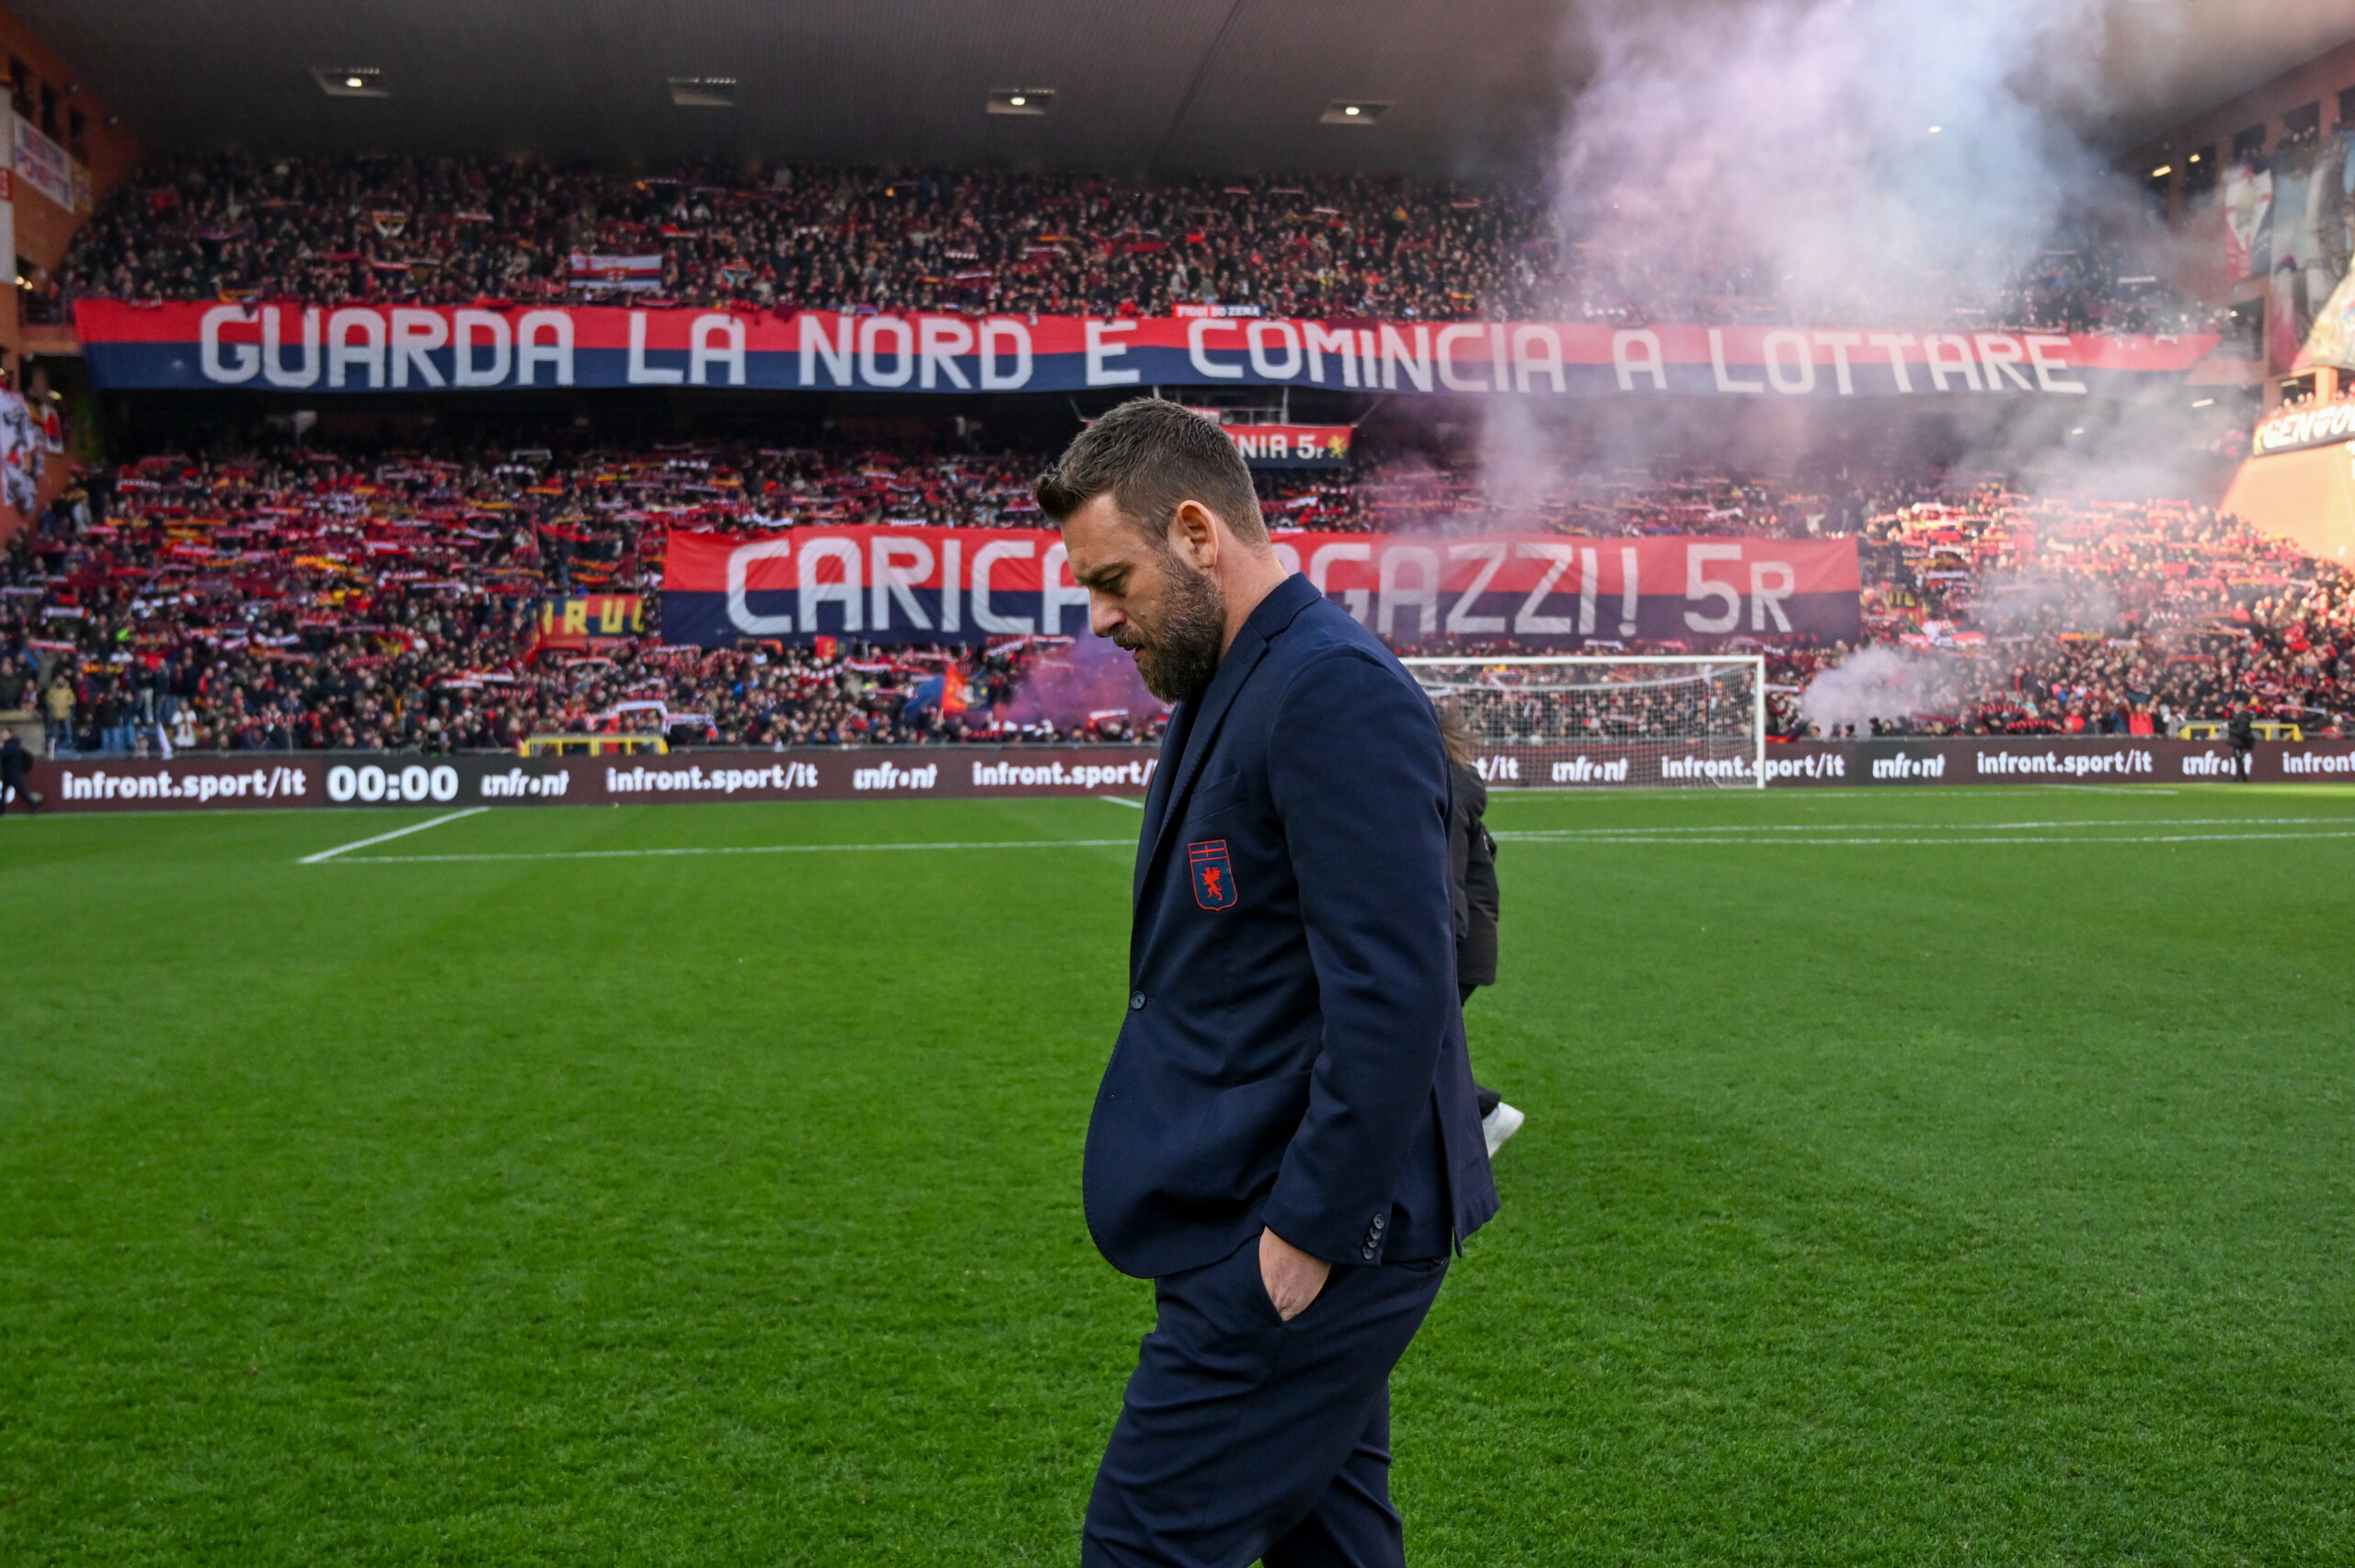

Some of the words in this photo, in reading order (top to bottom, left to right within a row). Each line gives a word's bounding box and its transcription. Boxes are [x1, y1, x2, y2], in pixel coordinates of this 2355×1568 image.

[201, 305, 574, 386] GUARDA
[627, 311, 746, 385] LA
[798, 315, 1038, 390] NORD
[1085, 319, 1141, 386] E
[1189, 318, 1566, 394] COMINCIA
[1612, 328, 1667, 391] A
[1706, 327, 2087, 395] LOTTARE
[1230, 432, 1289, 461] NIA
[726, 535, 1090, 635] CARICA
[1281, 541, 1638, 637] GAZZI!
[605, 761, 819, 794] infront.sport/it
[972, 759, 1160, 789] infront.sport/
[1976, 749, 2153, 779] infront.sport/it
[62, 766, 306, 803] infront.sport/it
[327, 765, 459, 802] 00:00
